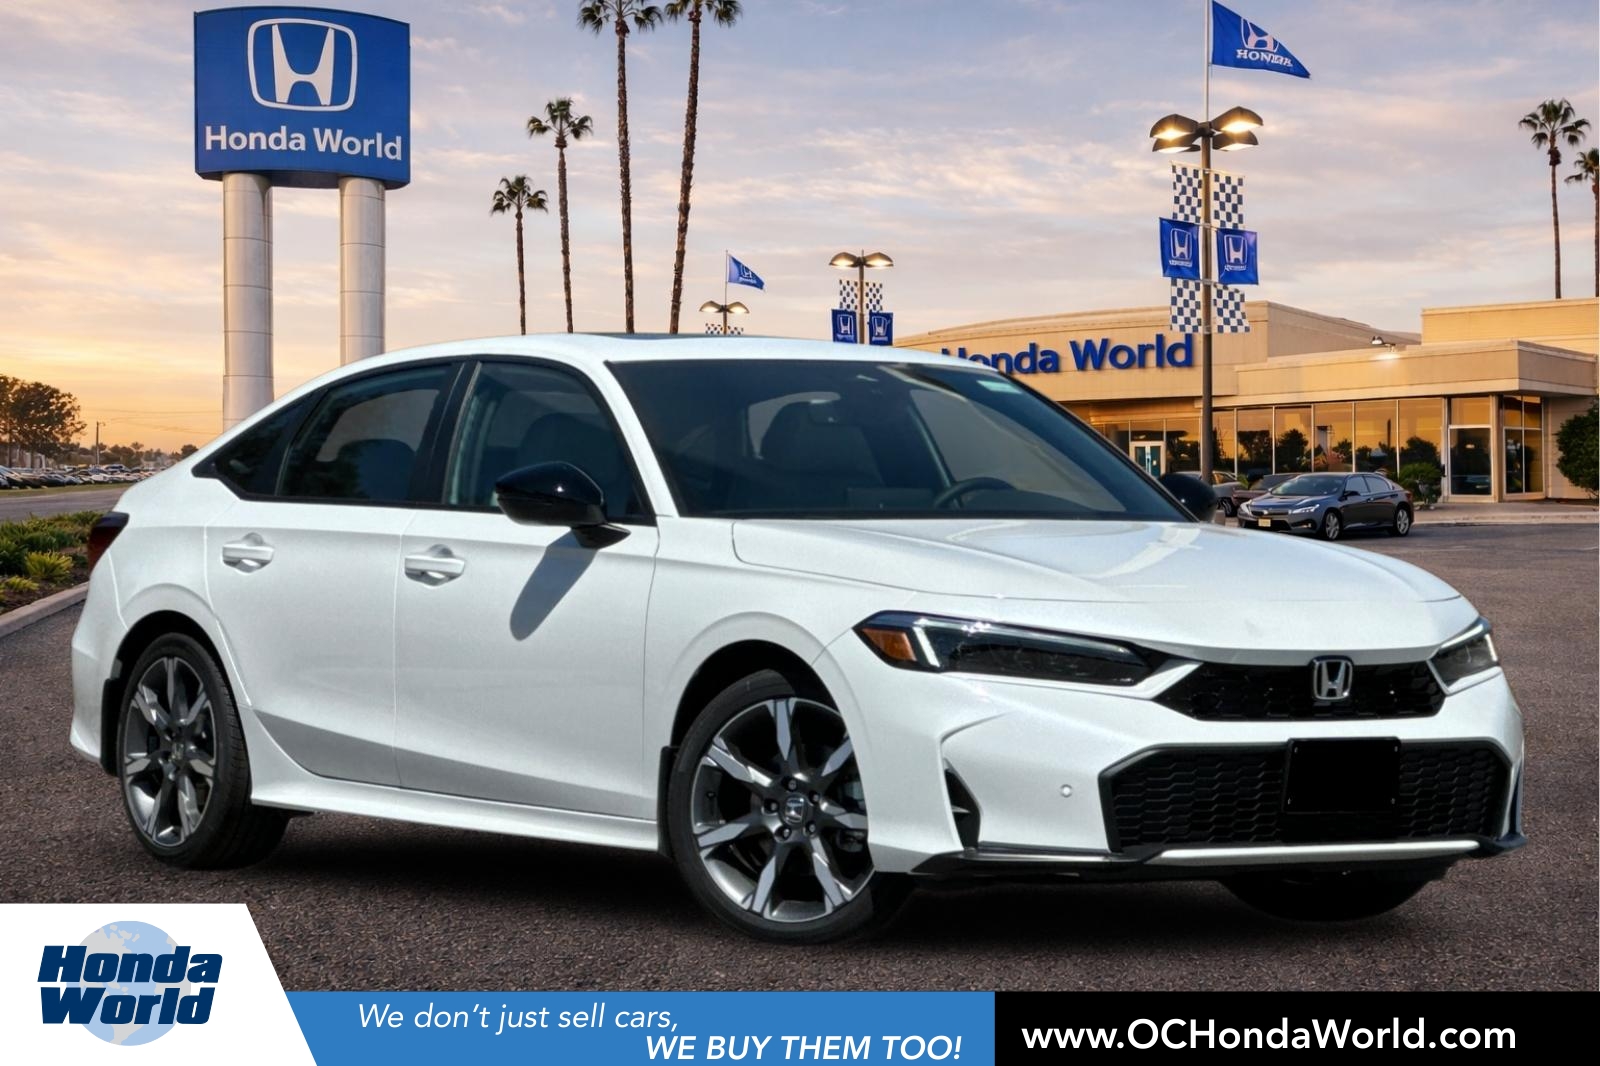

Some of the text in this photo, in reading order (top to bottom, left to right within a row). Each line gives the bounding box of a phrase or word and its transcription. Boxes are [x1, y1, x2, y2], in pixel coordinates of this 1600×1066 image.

[205, 125, 402, 161] Honda World
[941, 333, 1194, 375] nda World
